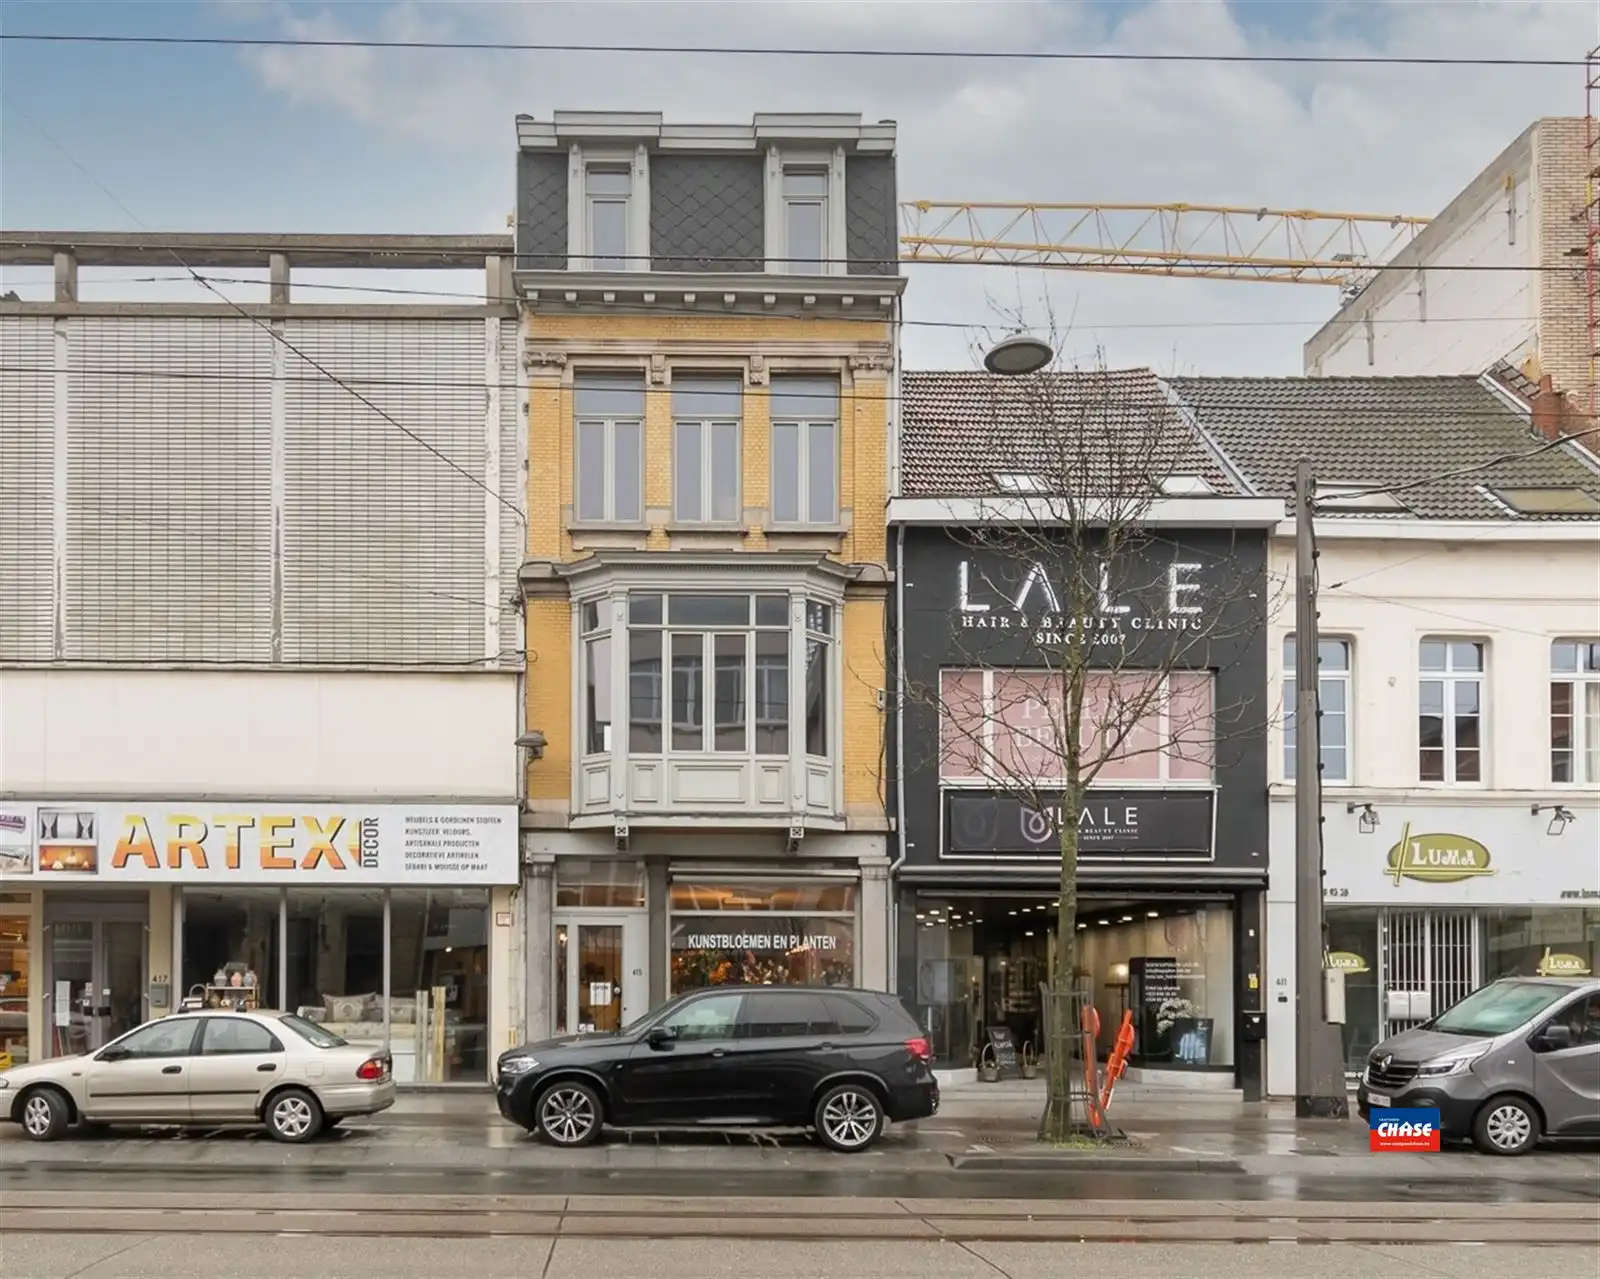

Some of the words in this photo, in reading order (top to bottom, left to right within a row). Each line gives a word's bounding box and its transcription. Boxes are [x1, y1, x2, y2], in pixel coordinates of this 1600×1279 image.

[960, 560, 1203, 613] LALE
[962, 616, 1010, 629] HAIR
[1131, 617, 1202, 630] CLINIC
[1036, 632, 1086, 645] SINCE
[1058, 806, 1138, 826] LALE
[362, 817, 379, 868] DECOR
[688, 935, 771, 949] KUNSTBLOEMEN
[773, 936, 787, 949] EN
[789, 935, 836, 950] PLANTEN
